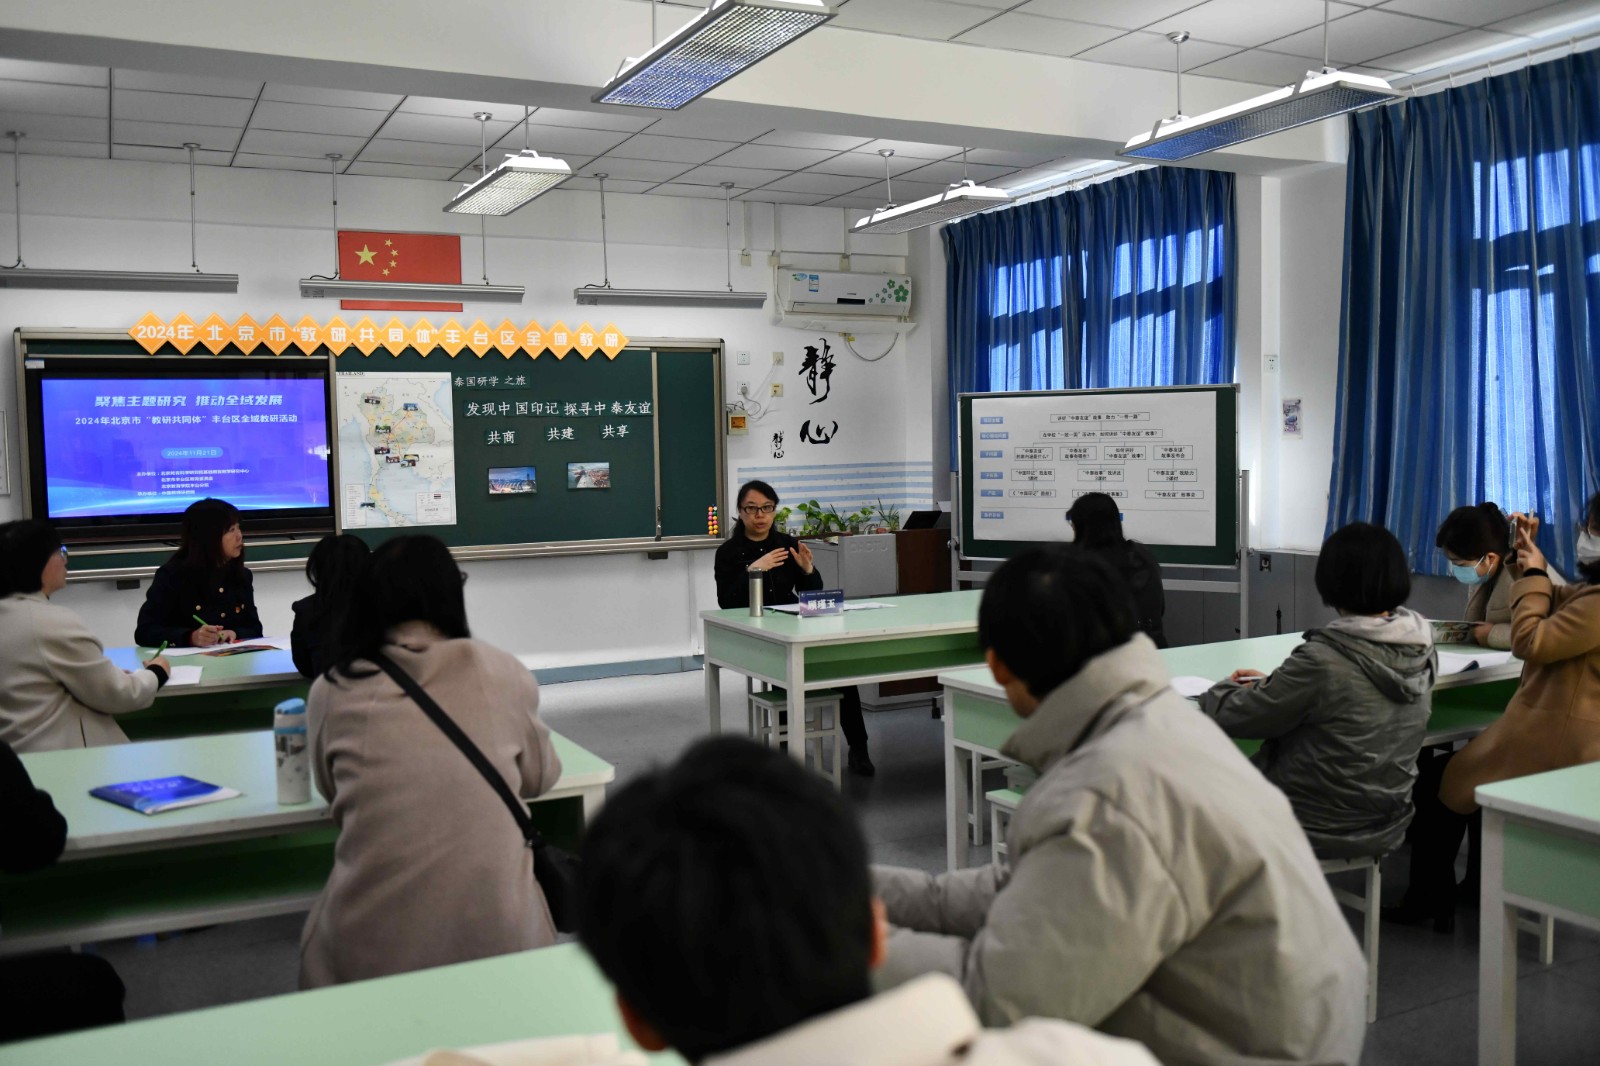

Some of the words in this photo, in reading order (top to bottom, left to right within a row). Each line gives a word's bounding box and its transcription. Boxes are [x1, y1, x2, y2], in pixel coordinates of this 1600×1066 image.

[94, 395, 186, 407] 聚焦主题研究
[196, 395, 283, 406] 推动全域发展
[487, 430, 515, 445] 共商
[547, 426, 575, 441] 共建
[602, 424, 629, 438] 共享
[168, 448, 217, 457] 2024年11月21日
